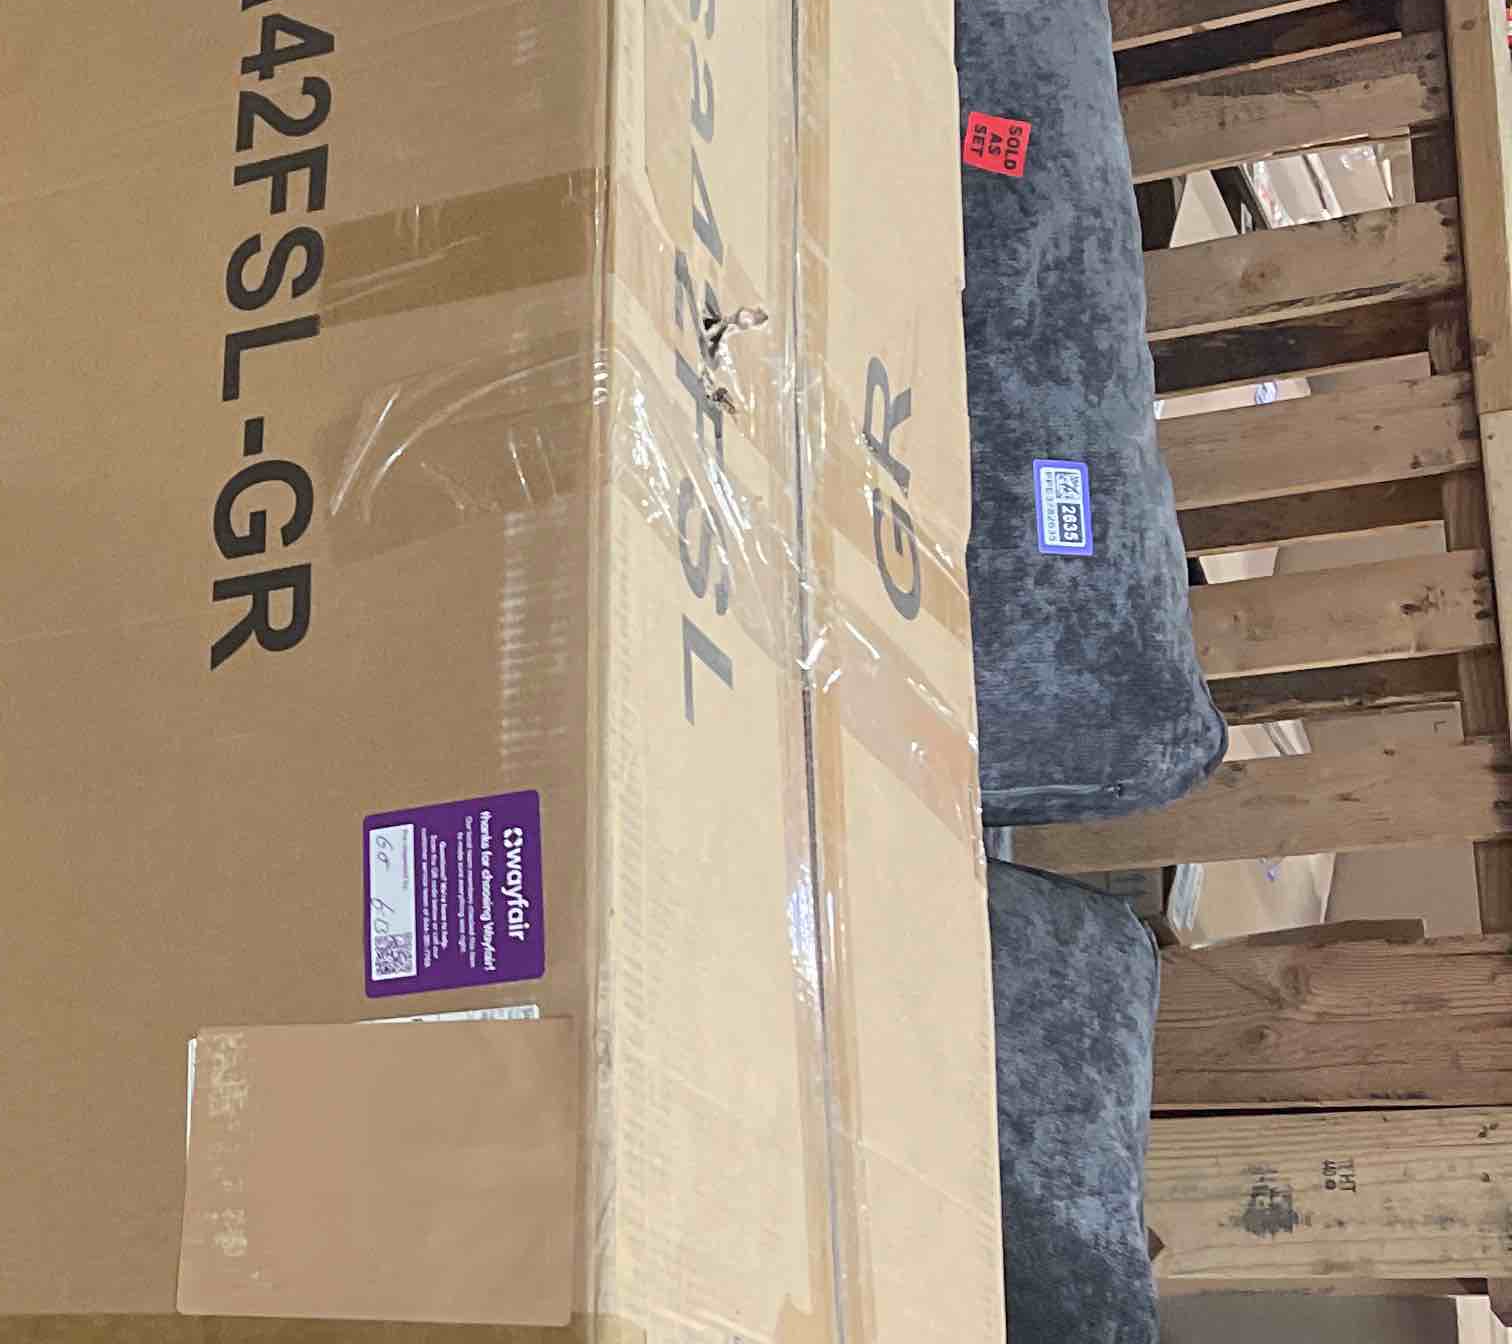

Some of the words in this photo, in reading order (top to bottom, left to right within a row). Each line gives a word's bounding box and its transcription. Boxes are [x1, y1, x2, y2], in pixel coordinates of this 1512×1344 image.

[970, 124, 988, 159] SET
[987, 133, 1003, 156] AS
[1003, 126, 1023, 171] SOLD
[862, 357, 922, 621] GR
[1061, 505, 1079, 542] 2635
[480, 811, 492, 849] thanks
[481, 851, 493, 867] for
[480, 870, 494, 921] choosing
[501, 848, 530, 941] wayfair
[481, 923, 496, 971] Wayfair!
